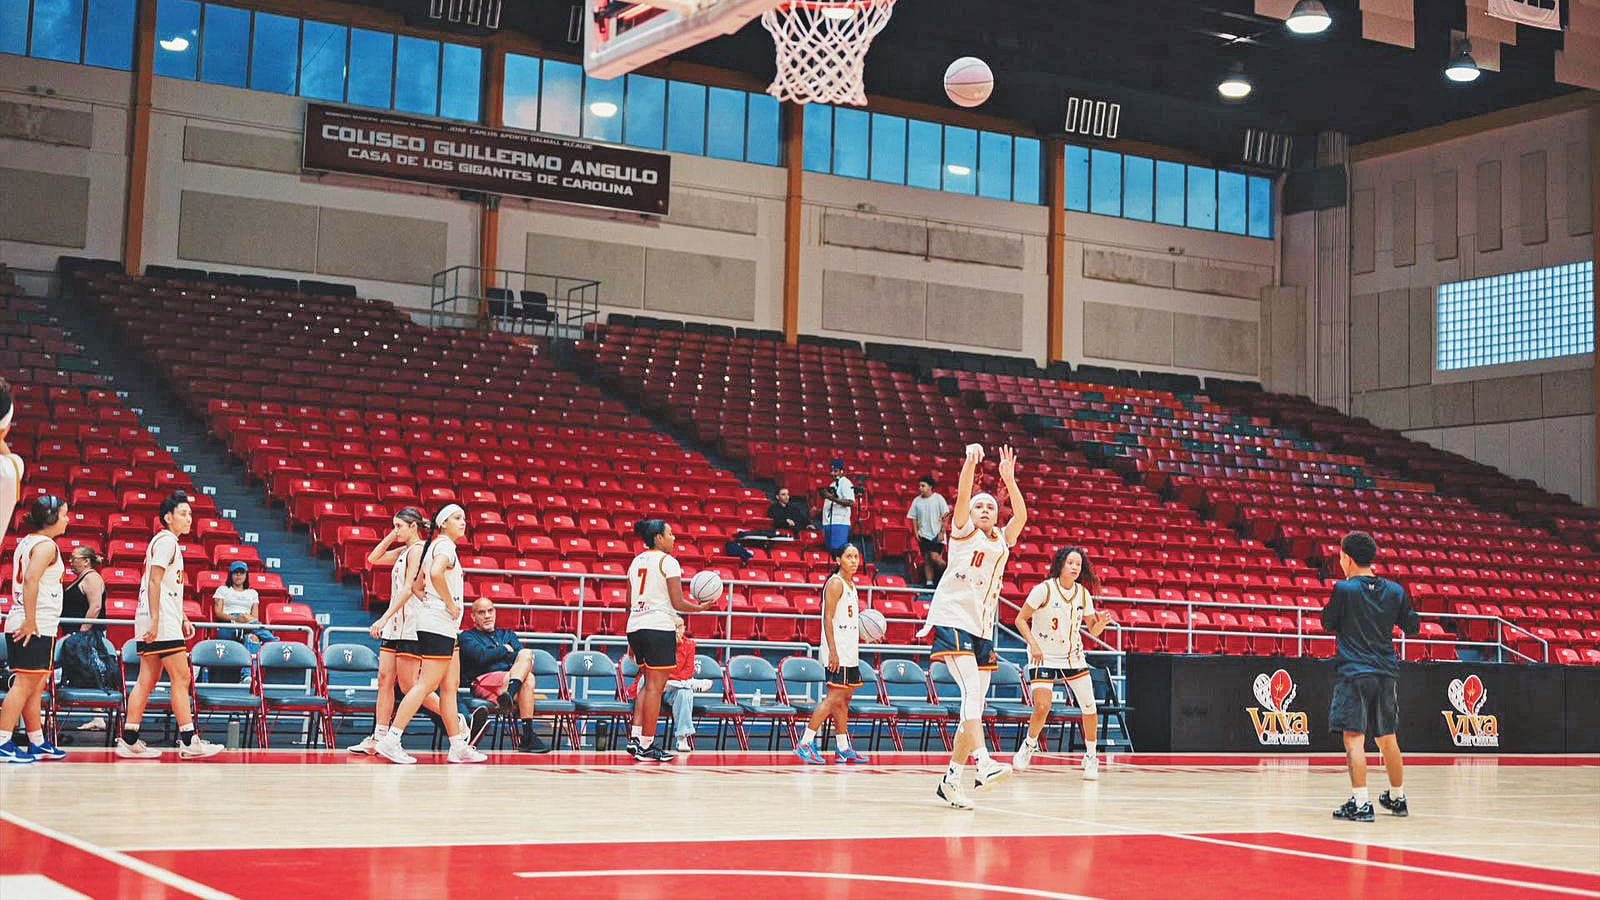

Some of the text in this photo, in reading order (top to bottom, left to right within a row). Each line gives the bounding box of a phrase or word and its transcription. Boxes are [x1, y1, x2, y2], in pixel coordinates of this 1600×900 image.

[321, 124, 658, 185] COLISEO GUILLERMO ANGULO
[347, 148, 633, 196] CASA DE LOS GIGANTES DE CAROLINA
[970, 550, 985, 568] 10
[637, 568, 648, 596] 7
[847, 605, 853, 618] 5
[1051, 617, 1059, 631] 3
